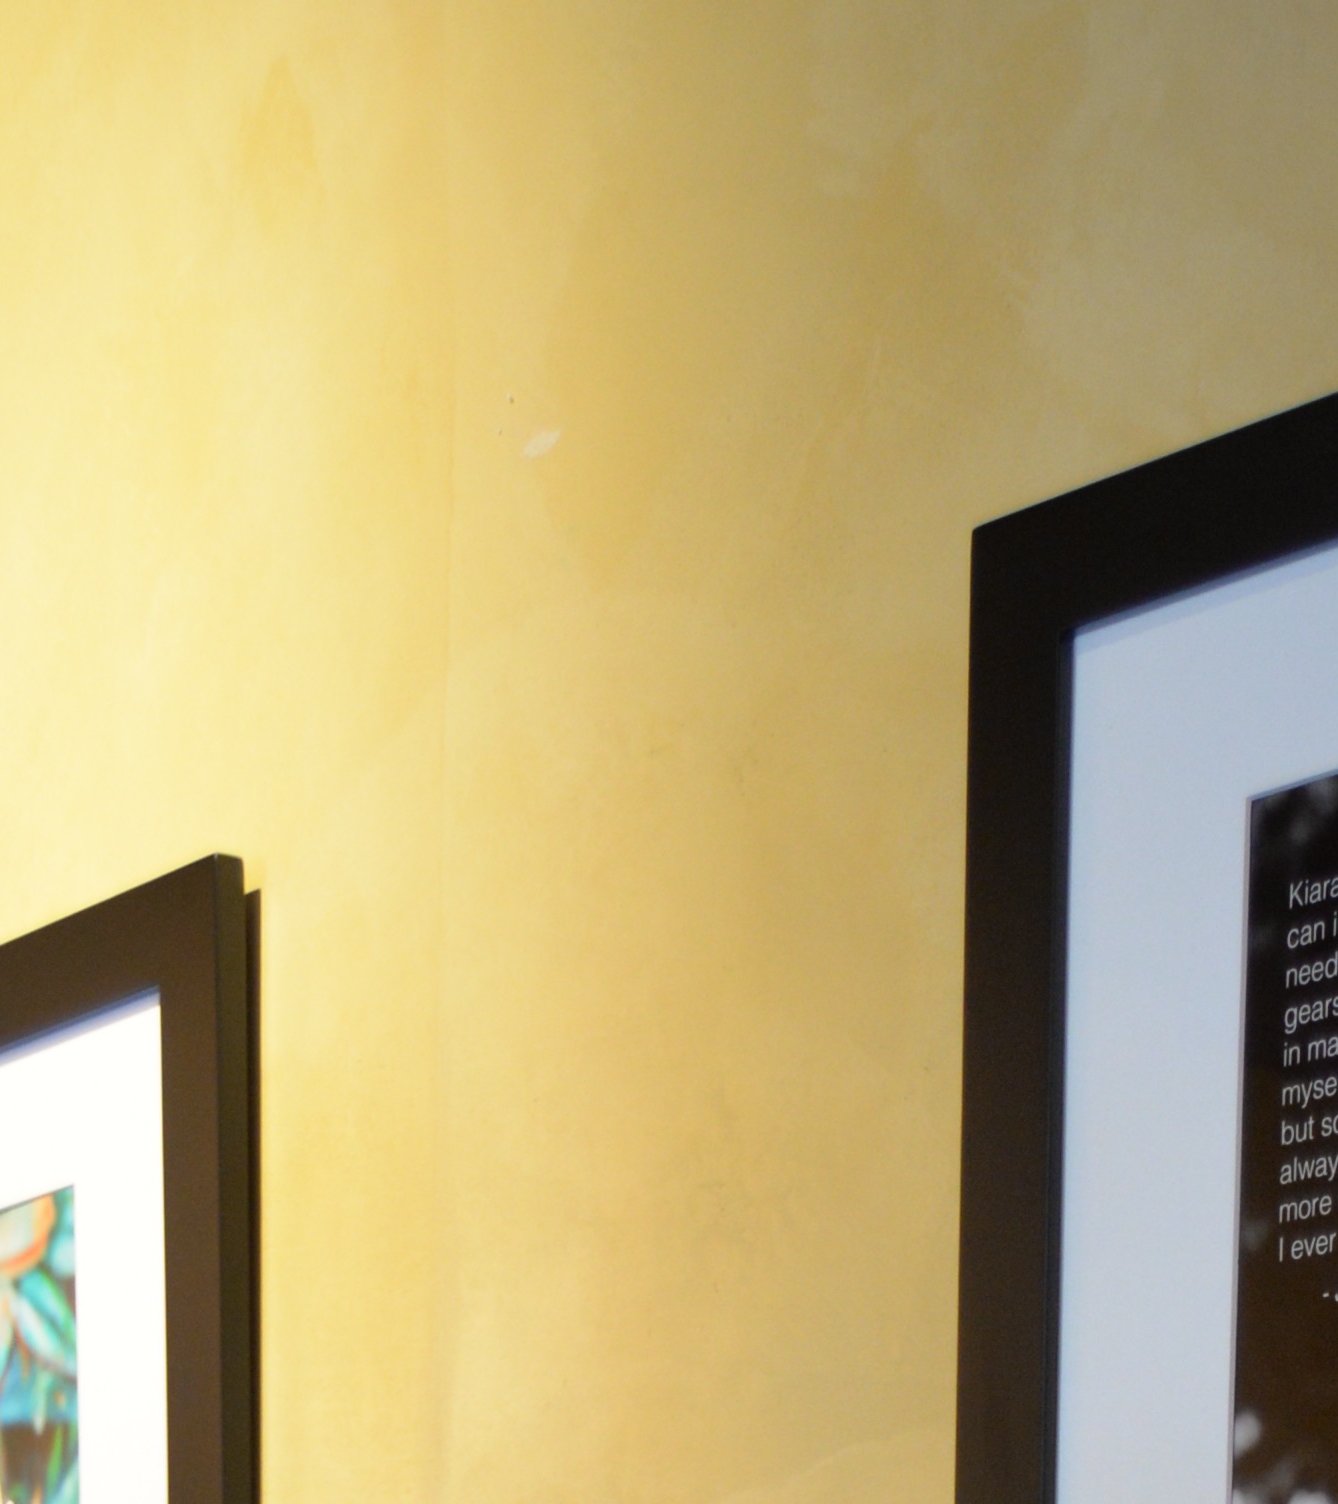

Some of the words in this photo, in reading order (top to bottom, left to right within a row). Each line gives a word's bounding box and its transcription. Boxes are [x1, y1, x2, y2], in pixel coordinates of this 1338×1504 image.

[1286, 920, 1325, 949] can
[1283, 1042, 1301, 1067] in
[1281, 1115, 1315, 1145] but
[1279, 1194, 1333, 1223] more
[1279, 1236, 1284, 1262] I
[1290, 1232, 1337, 1260] ever
